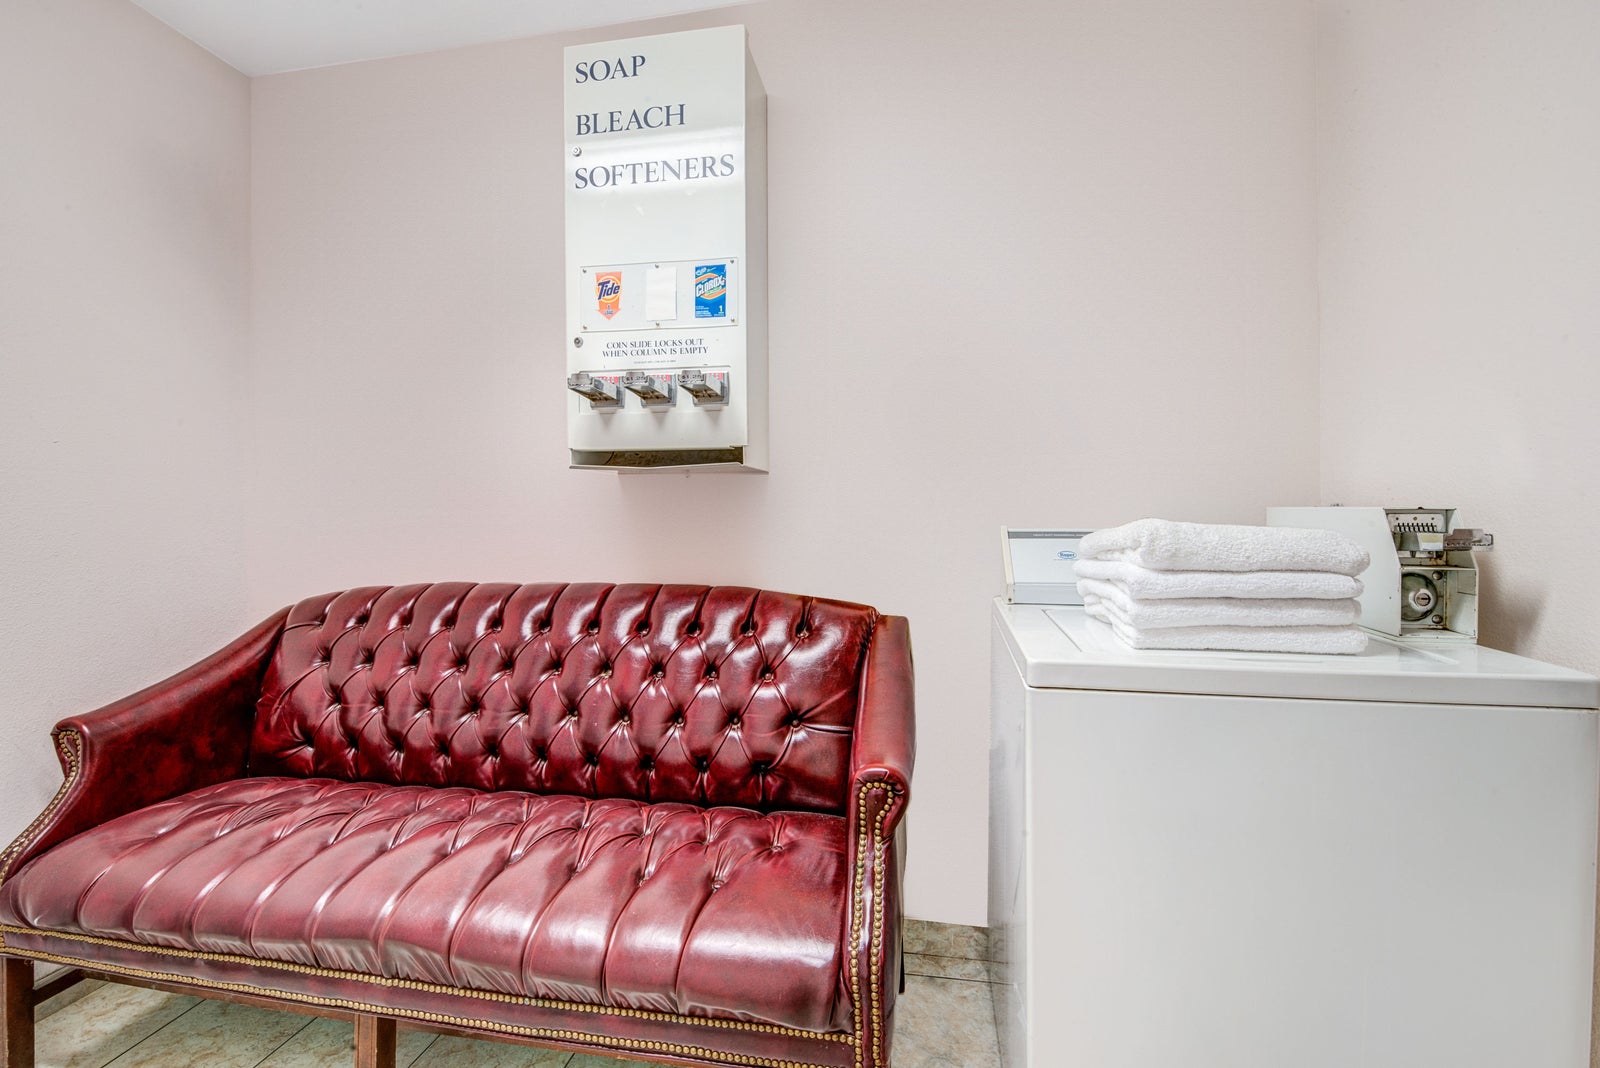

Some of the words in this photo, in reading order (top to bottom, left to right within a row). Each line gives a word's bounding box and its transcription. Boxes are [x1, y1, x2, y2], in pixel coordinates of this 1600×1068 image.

[575, 55, 646, 84] SOAP
[575, 104, 686, 136] BLEACH
[575, 154, 735, 189] SOFTENERS
[597, 280, 620, 300] Tide
[654, 339, 683, 347] LOCKS
[685, 338, 704, 346] OUT
